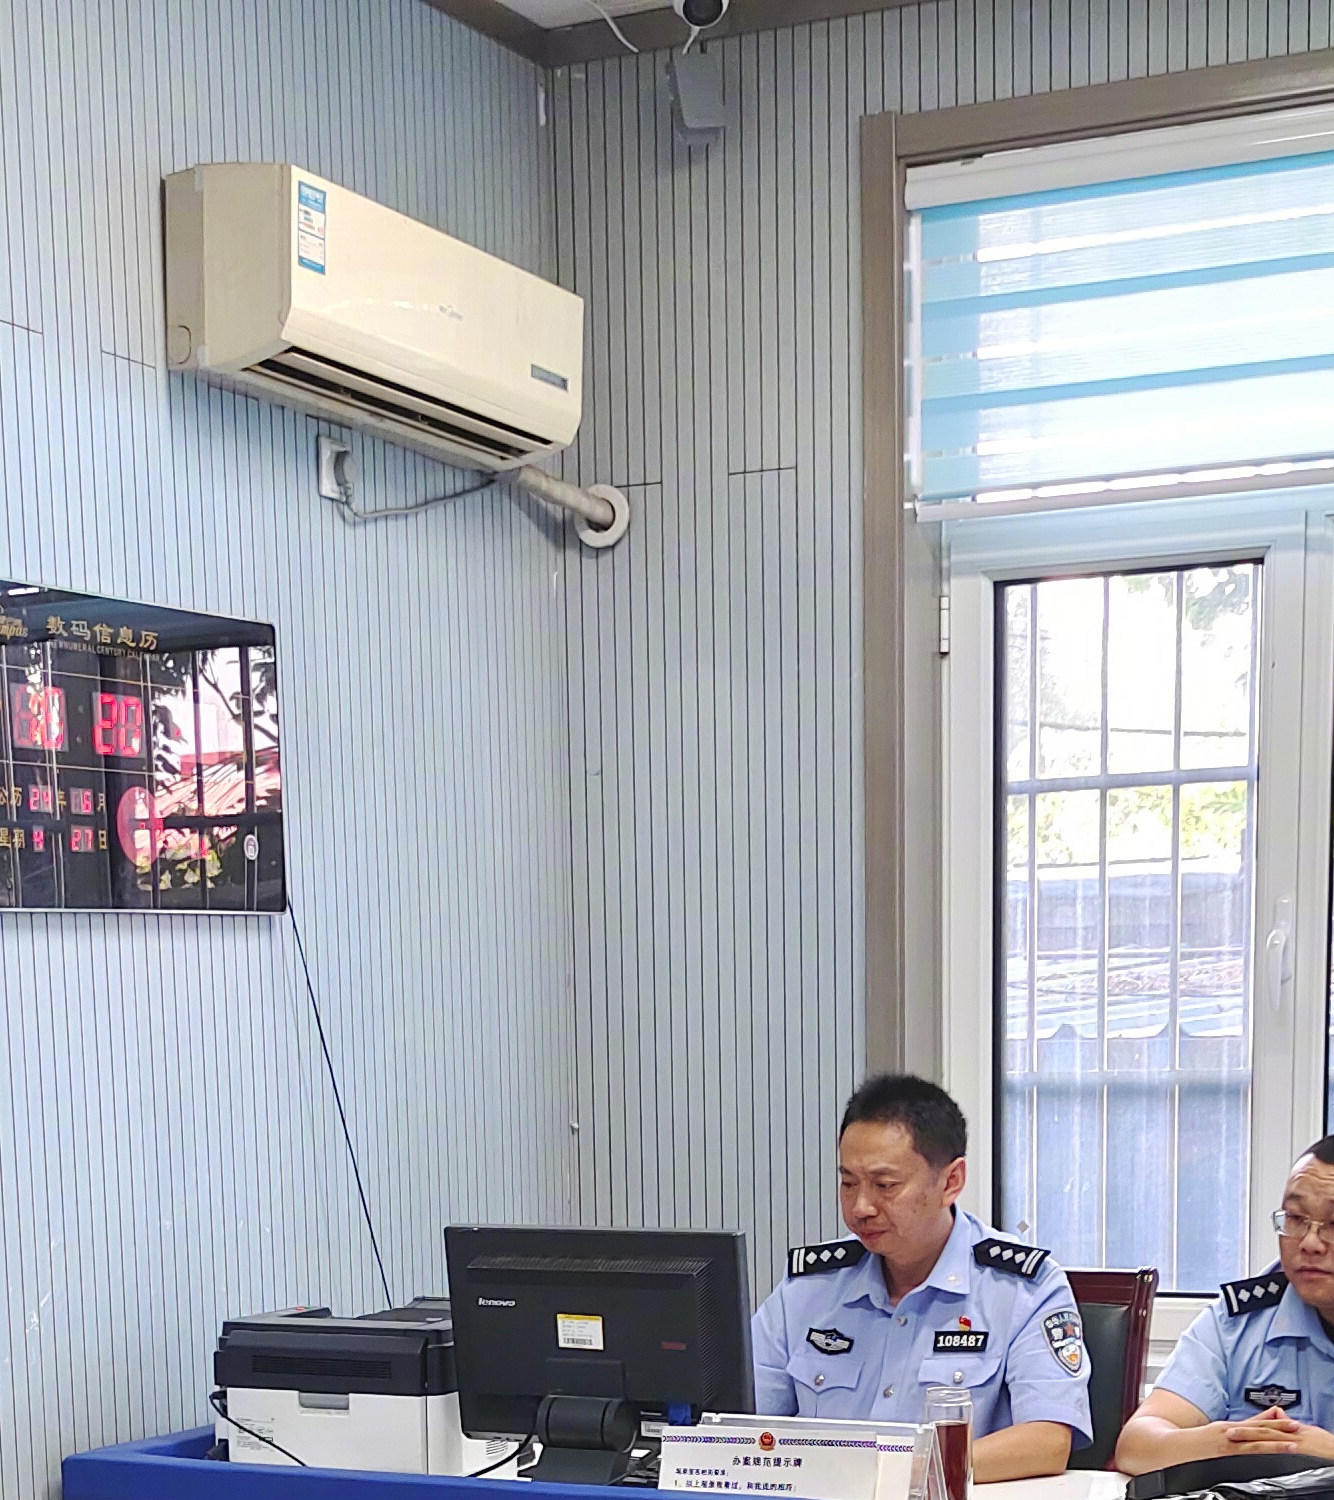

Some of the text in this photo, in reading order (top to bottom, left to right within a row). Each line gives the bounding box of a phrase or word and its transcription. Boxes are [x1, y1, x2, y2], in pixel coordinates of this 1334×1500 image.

[46, 615, 159, 650] 数码信息历
[936, 1334, 985, 1348] 108487
[732, 1456, 803, 1468] 办案规范提示牌
